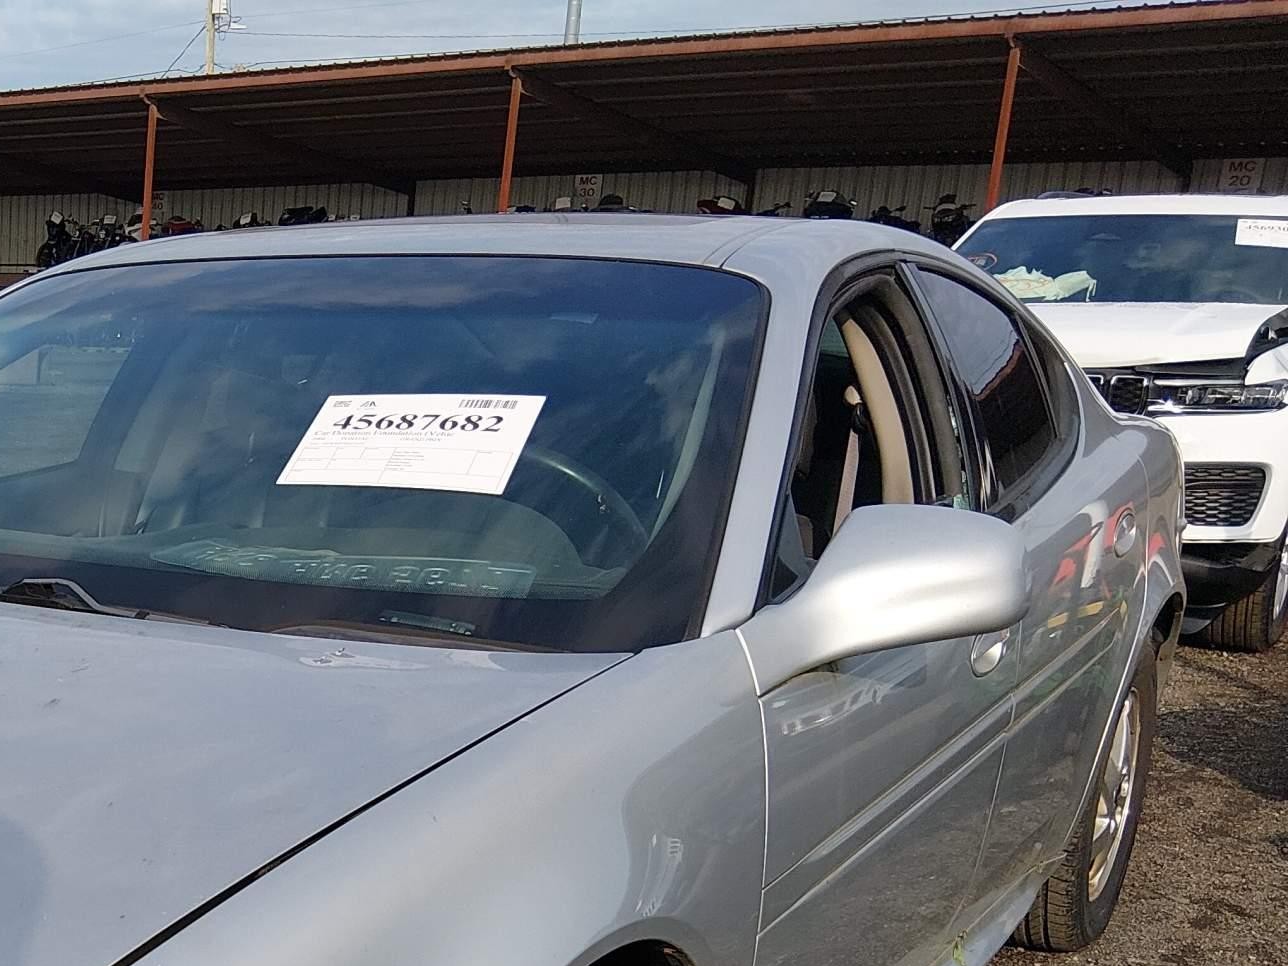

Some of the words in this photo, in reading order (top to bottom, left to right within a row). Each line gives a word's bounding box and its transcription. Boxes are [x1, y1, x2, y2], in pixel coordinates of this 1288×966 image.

[578, 175, 598, 186] MC
[1228, 174, 1252, 186] 20
[578, 187, 596, 197] 30
[332, 413, 504, 433] 45687682
